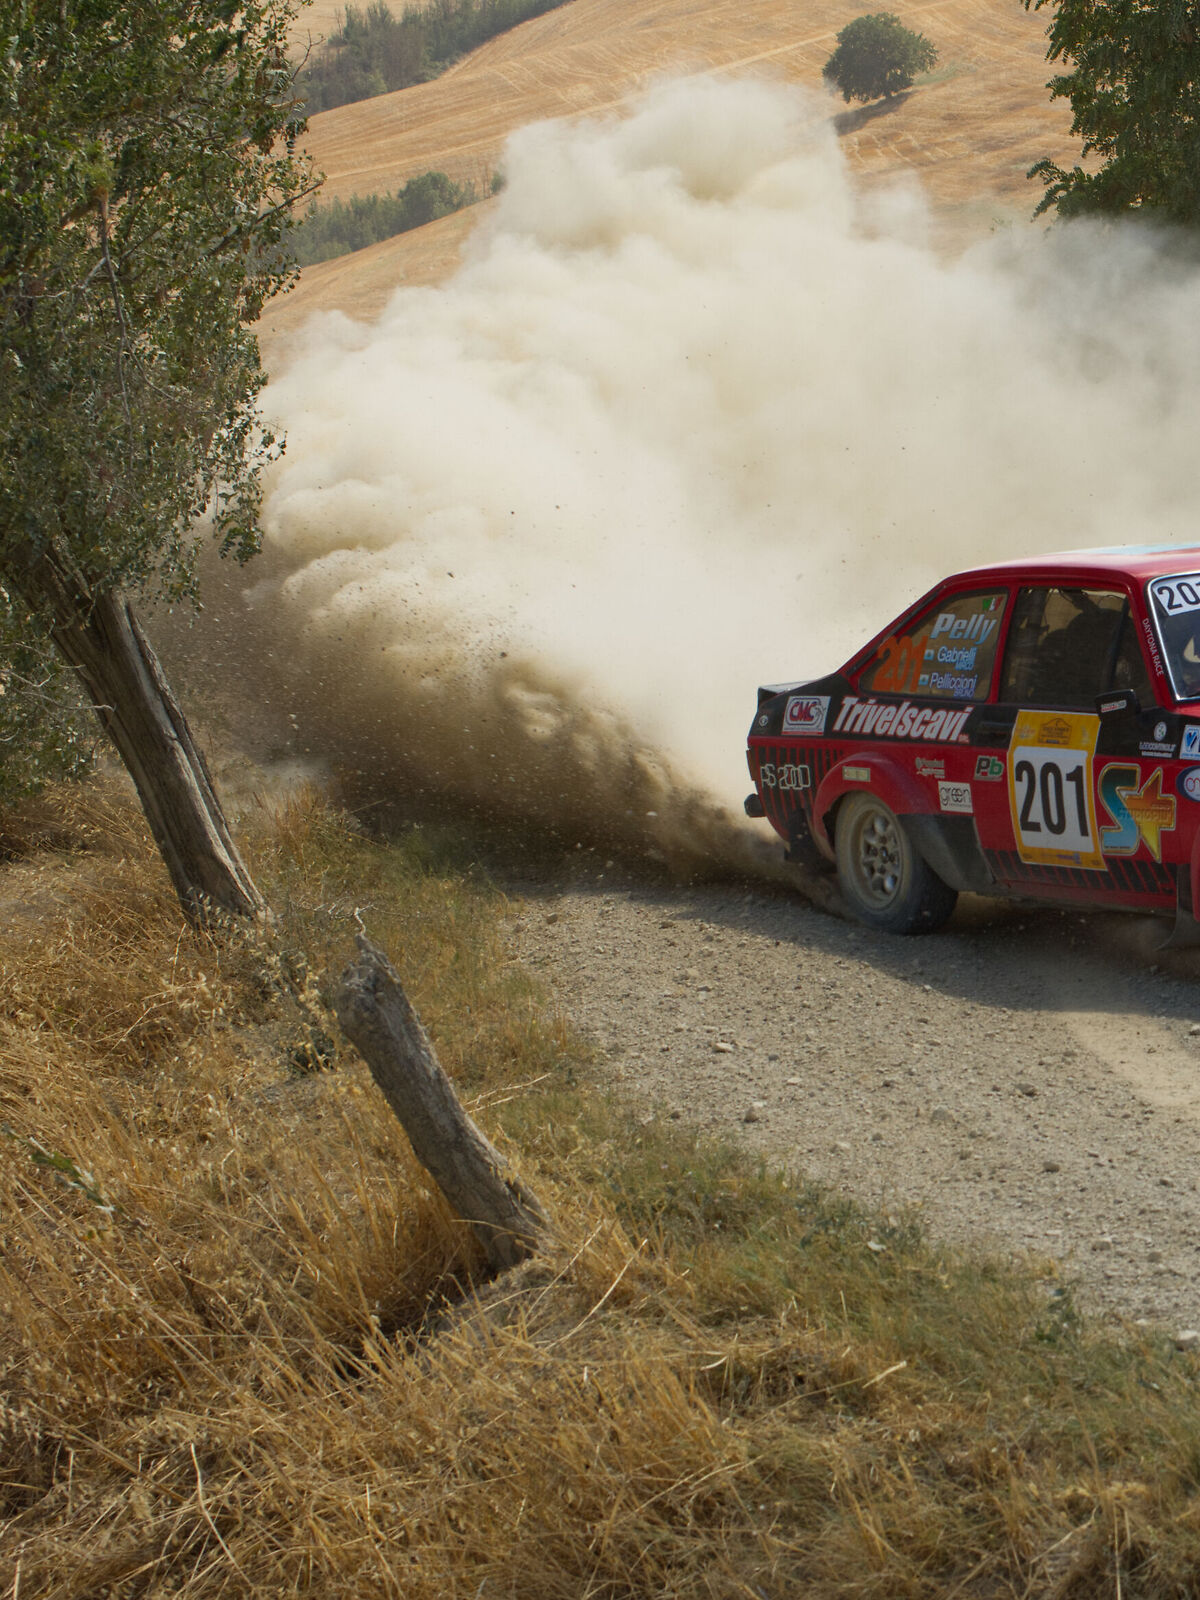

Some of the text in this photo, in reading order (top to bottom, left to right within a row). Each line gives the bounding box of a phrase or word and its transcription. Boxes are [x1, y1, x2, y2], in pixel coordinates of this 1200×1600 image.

[930, 613, 997, 645] Pelly
[1142, 617, 1164, 677] DAYTONA RACE
[872, 635, 929, 693] 201
[937, 645, 977, 663] Gabrielli
[789, 701, 817, 722] CMC
[832, 696, 975, 743] Trivelscavi
[760, 763, 776, 788] RS
[1015, 760, 1089, 837] 201
